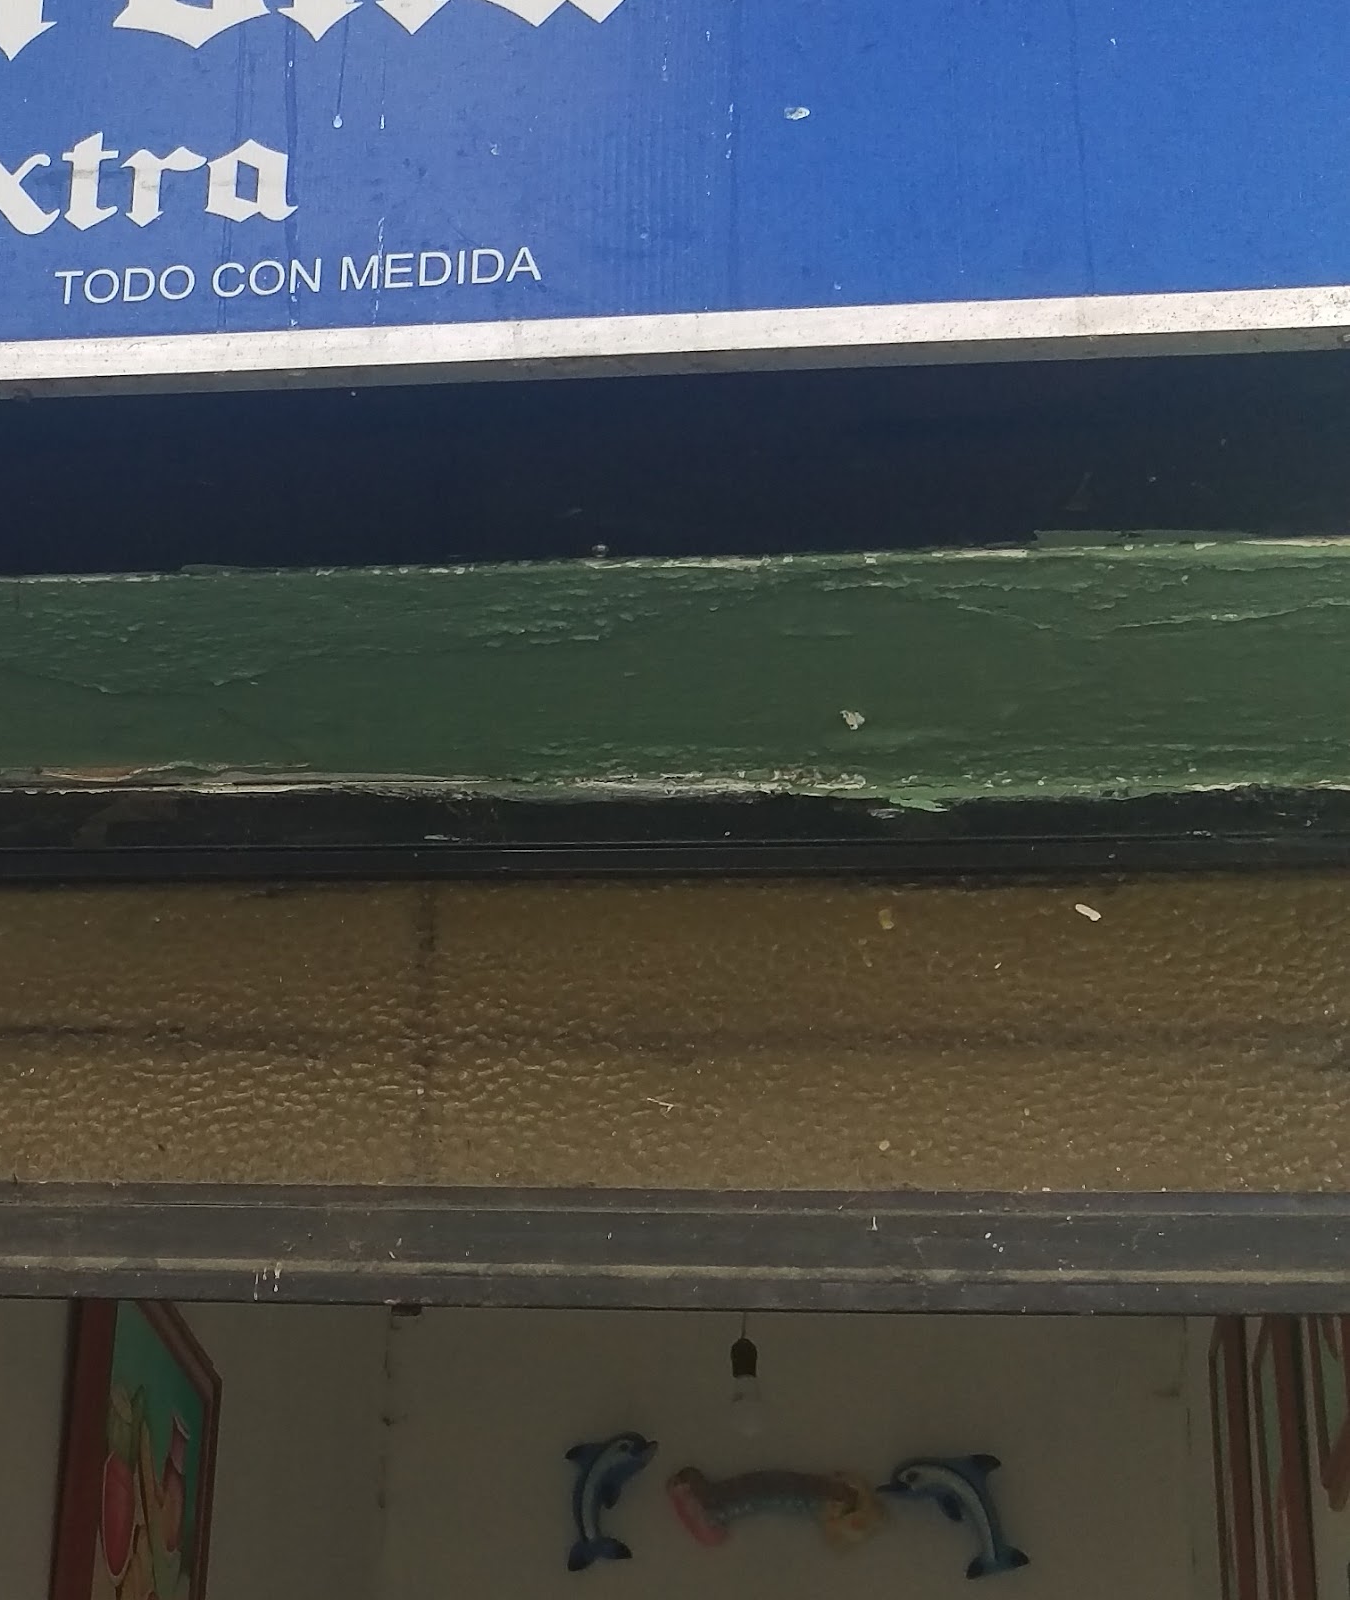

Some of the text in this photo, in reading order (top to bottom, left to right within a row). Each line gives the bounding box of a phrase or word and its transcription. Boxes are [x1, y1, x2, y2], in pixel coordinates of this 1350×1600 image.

[54, 264, 196, 305] TODO
[212, 258, 323, 298] CON
[340, 245, 543, 292] MEDIDA
